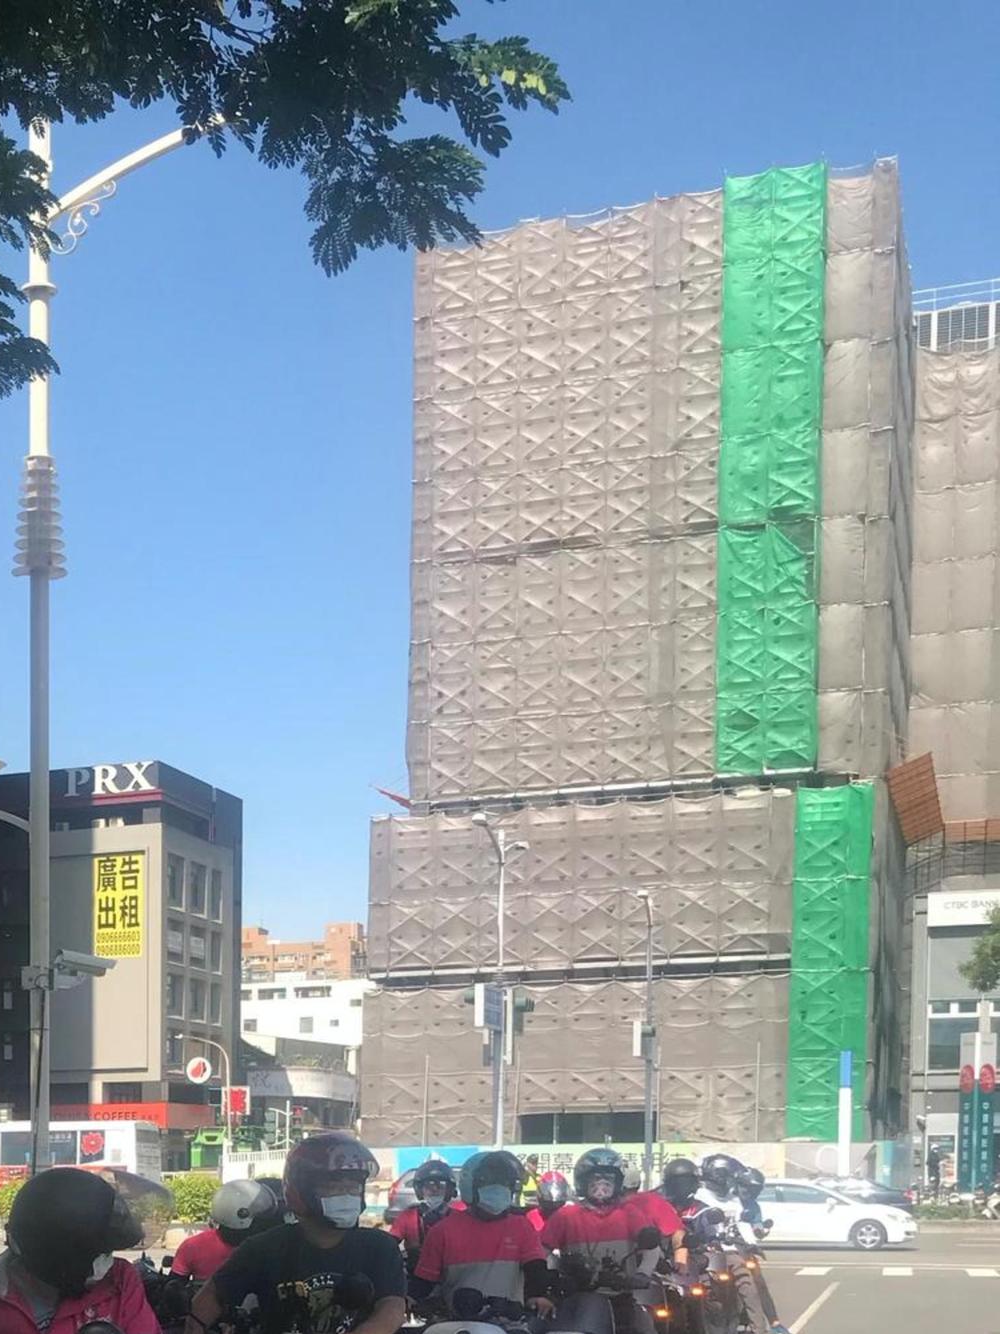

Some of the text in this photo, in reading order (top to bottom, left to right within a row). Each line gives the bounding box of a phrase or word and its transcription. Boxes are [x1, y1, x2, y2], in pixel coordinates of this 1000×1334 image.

[64, 761, 155, 797] PRX
[96, 856, 140, 892] 廣告
[97, 895, 140, 930] 出租
[944, 900, 969, 909] CTBC
[93, 1111, 137, 1121] COFFEE
